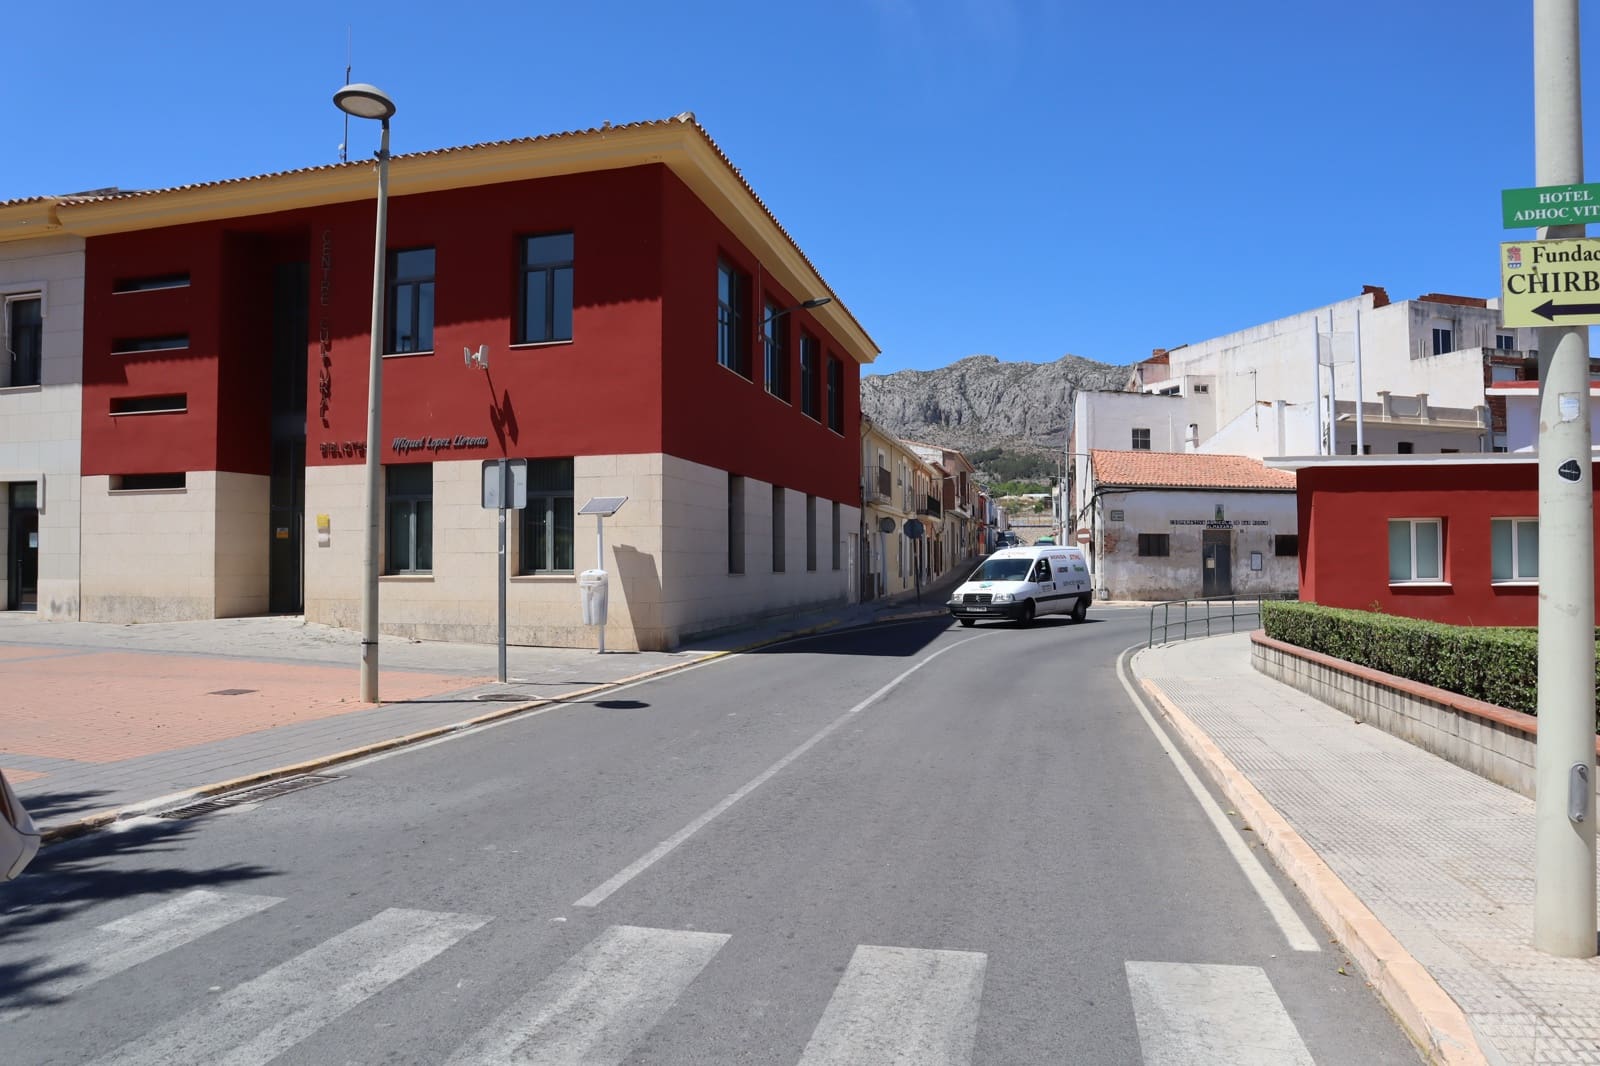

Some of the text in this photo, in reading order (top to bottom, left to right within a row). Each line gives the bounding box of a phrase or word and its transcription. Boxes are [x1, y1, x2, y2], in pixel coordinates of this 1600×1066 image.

[1539, 190, 1593, 204] HOTEL
[1514, 207, 1569, 221] ADHOC
[1507, 271, 1600, 295] CHIRB
[392, 436, 425, 454] Miguel
[426, 435, 450, 453] Lopez
